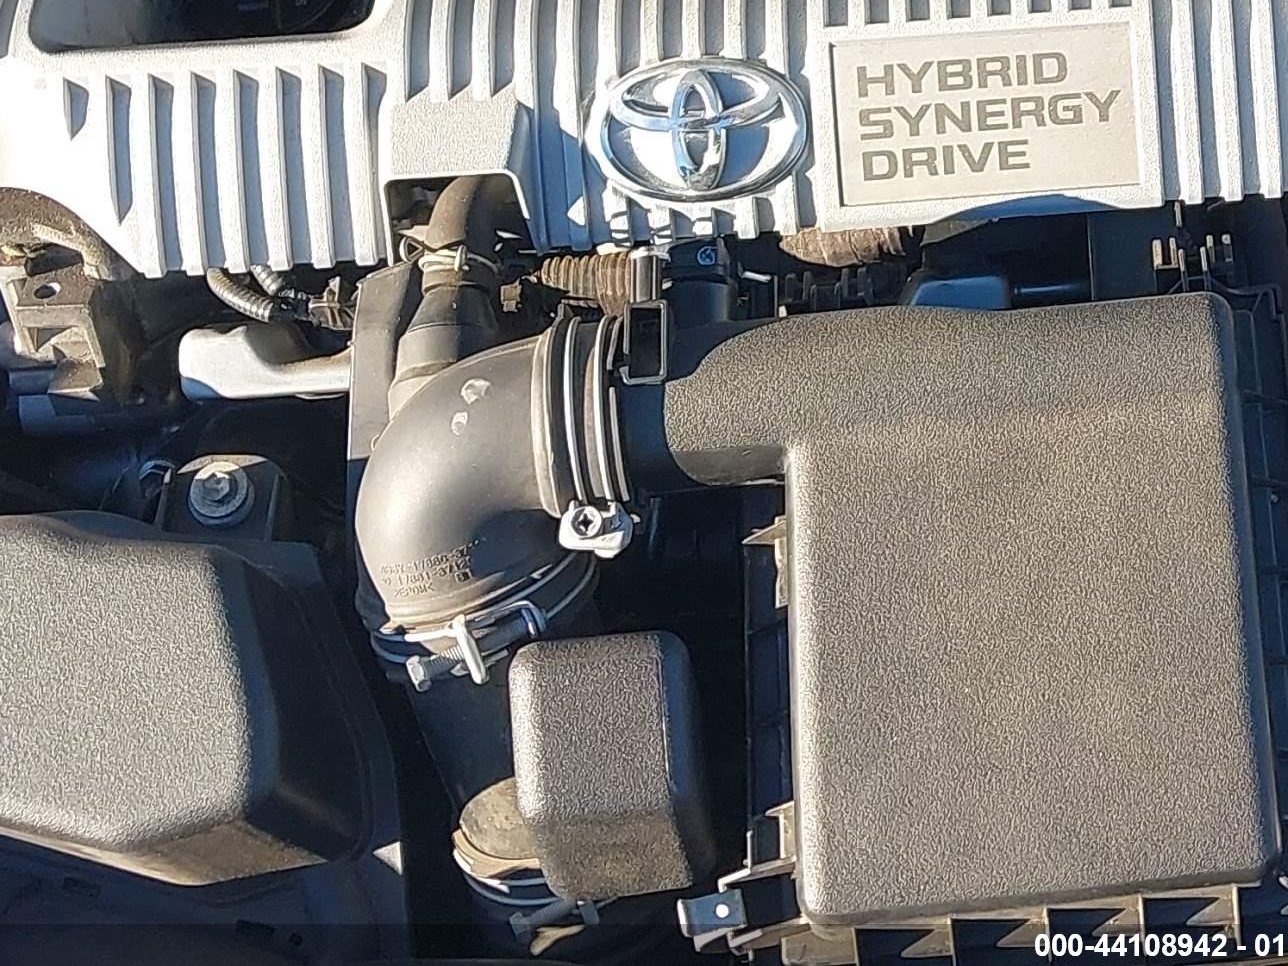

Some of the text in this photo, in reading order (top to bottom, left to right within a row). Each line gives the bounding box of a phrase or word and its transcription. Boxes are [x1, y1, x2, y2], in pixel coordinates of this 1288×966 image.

[856, 51, 1068, 99] HYBRID
[858, 89, 1121, 141] SYNERGY
[861, 139, 1030, 182] DRIVE
